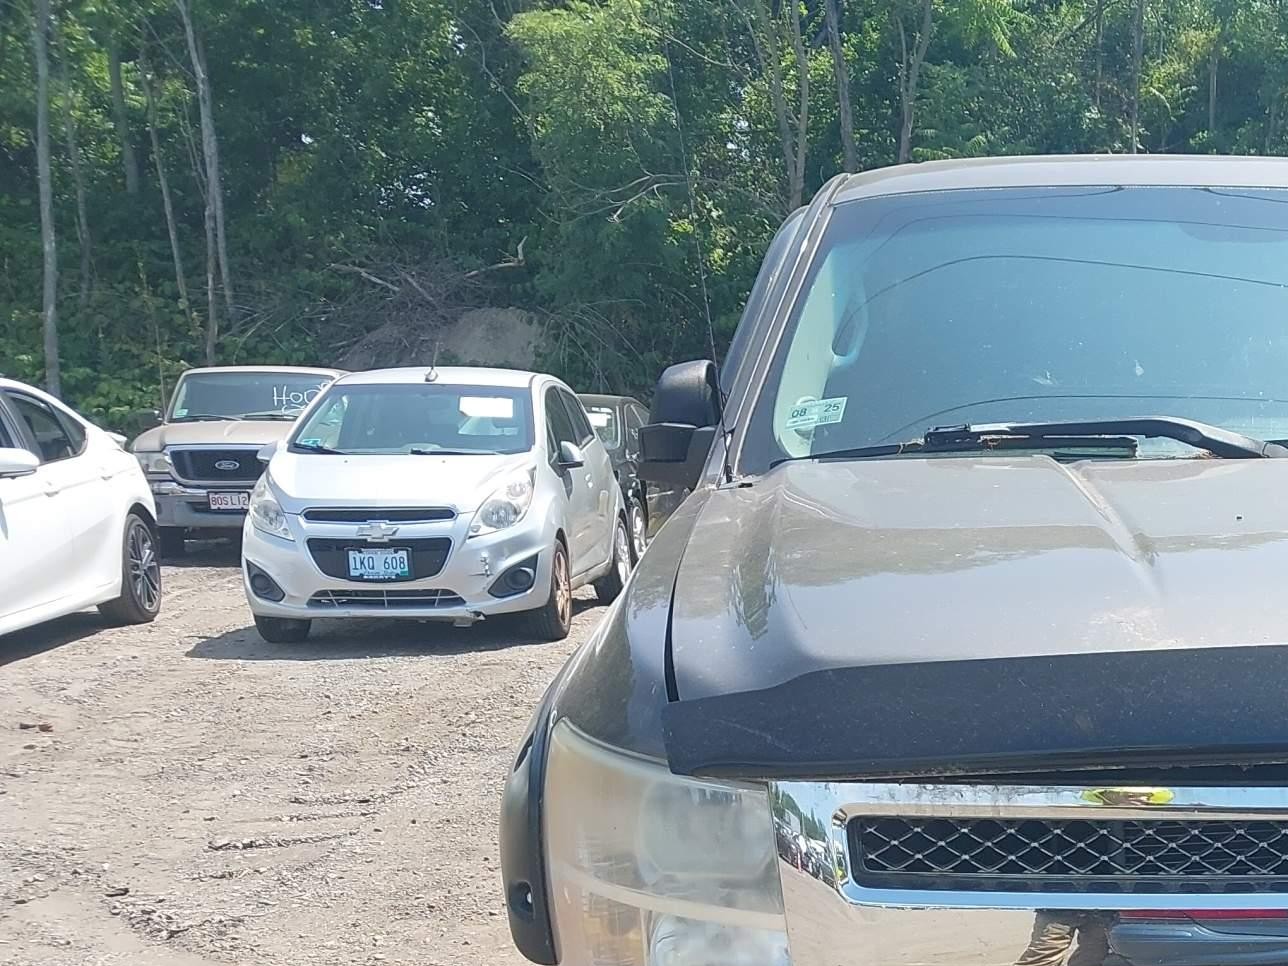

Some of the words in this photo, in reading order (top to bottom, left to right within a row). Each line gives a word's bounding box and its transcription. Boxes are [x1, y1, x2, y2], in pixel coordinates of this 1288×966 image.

[792, 408, 807, 418] 08
[824, 403, 840, 413] 25
[383, 556, 406, 570] 608
